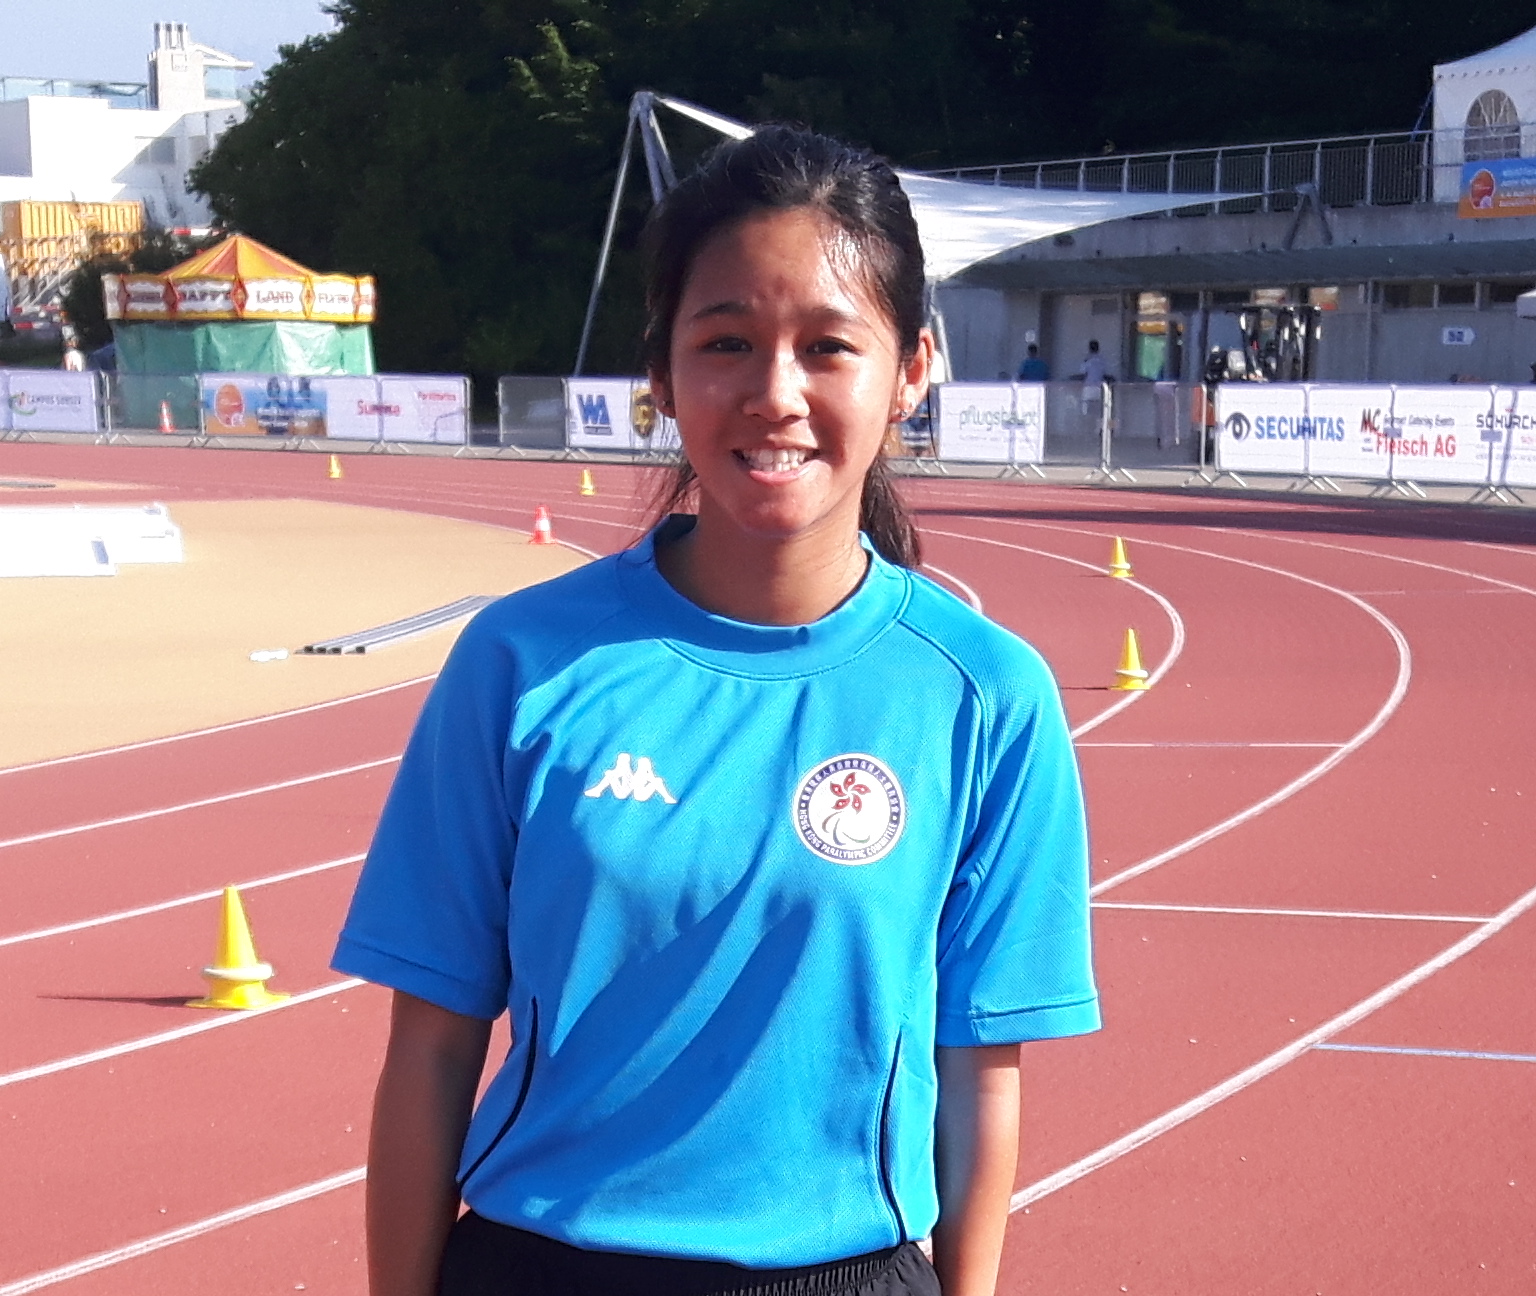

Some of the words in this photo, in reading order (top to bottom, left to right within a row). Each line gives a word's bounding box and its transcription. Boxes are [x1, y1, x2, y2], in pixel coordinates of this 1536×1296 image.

[1254, 416, 1345, 442] SECURITAS
[1376, 433, 1428, 456] Fleisch
[1434, 434, 1457, 457] AG
